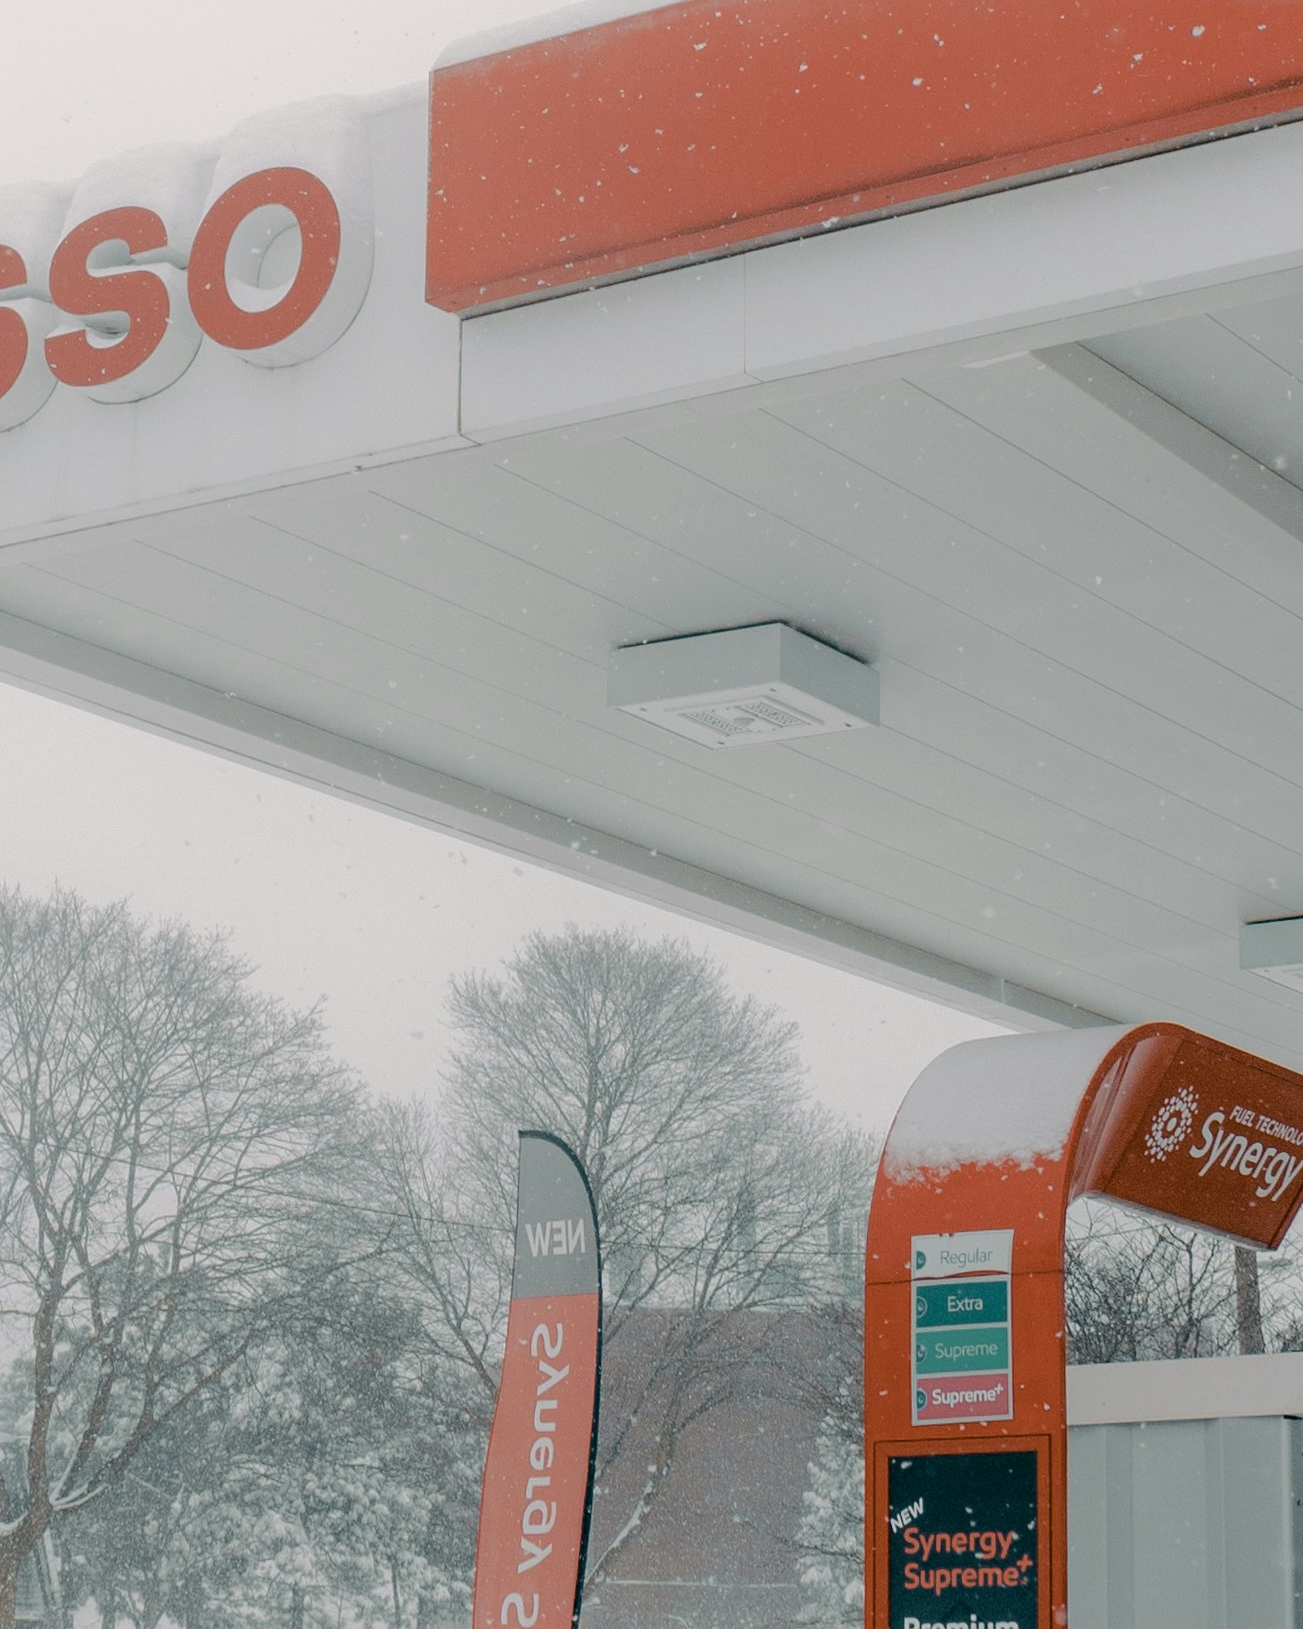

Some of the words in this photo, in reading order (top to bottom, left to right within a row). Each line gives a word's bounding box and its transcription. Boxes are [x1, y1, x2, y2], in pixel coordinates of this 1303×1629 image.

[1229, 1105, 1253, 1128] FUEL
[940, 1248, 994, 1269] Regular
[947, 1295, 984, 1313] Extra
[935, 1341, 999, 1361] Supreme
[890, 1496, 925, 1534] NEW
[903, 1526, 1014, 1562] Synergy
